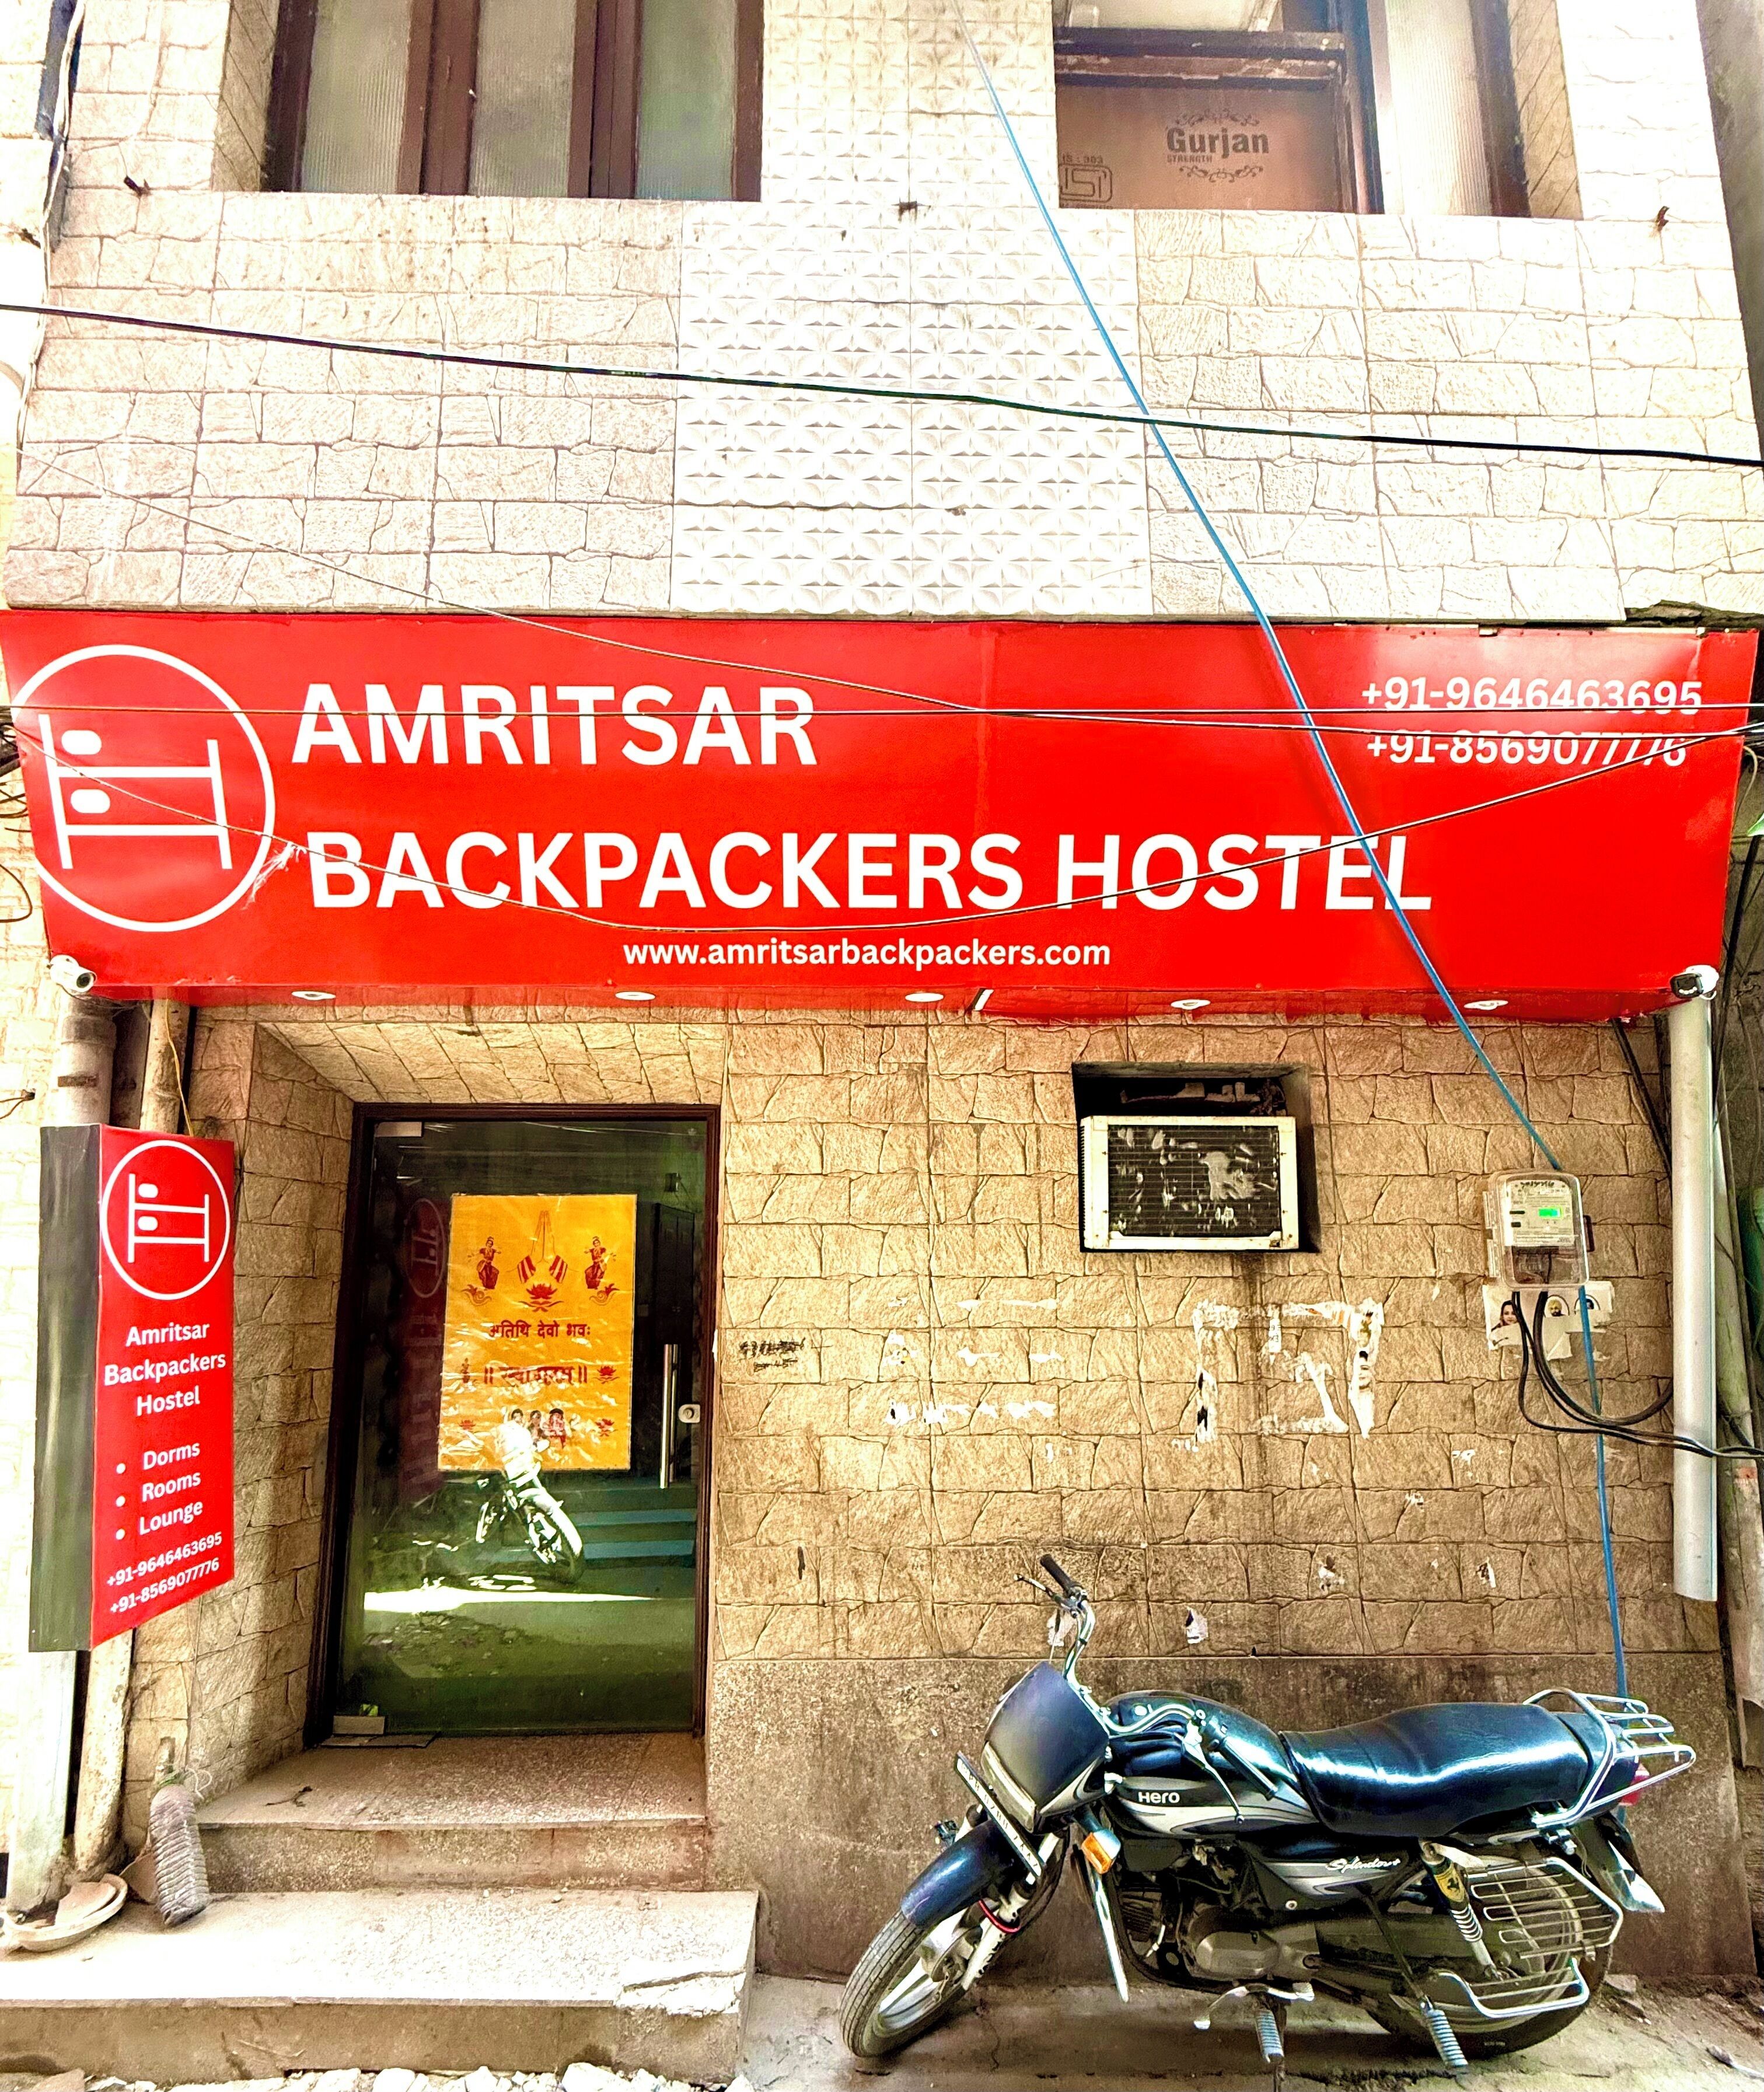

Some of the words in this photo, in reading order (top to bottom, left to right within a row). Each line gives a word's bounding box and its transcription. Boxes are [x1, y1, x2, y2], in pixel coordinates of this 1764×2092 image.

[1166, 127, 1269, 159] Gurjan
[1361, 676, 1703, 715] +91-9646463695
[291, 683, 818, 766] AMRITSAR
[306, 832, 1024, 911] BACKPACKERS
[1056, 833, 1433, 911] HOSTEL
[623, 938, 1111, 971] www.amritsarbackpackers.com
[125, 1322, 210, 1347] Amritsar
[537, 1319, 560, 1339] देवो
[104, 1353, 226, 1386] Backpackers
[137, 1385, 201, 1416] Hostel
[143, 1443, 200, 1470] Dorms
[142, 1472, 201, 1503] Rooms
[139, 1501, 203, 1535] Lounge
[107, 1531, 222, 1587] +91-9646463695
[110, 1557, 219, 1613] +91-8569077776
[1138, 1791, 1180, 1804] Hero
